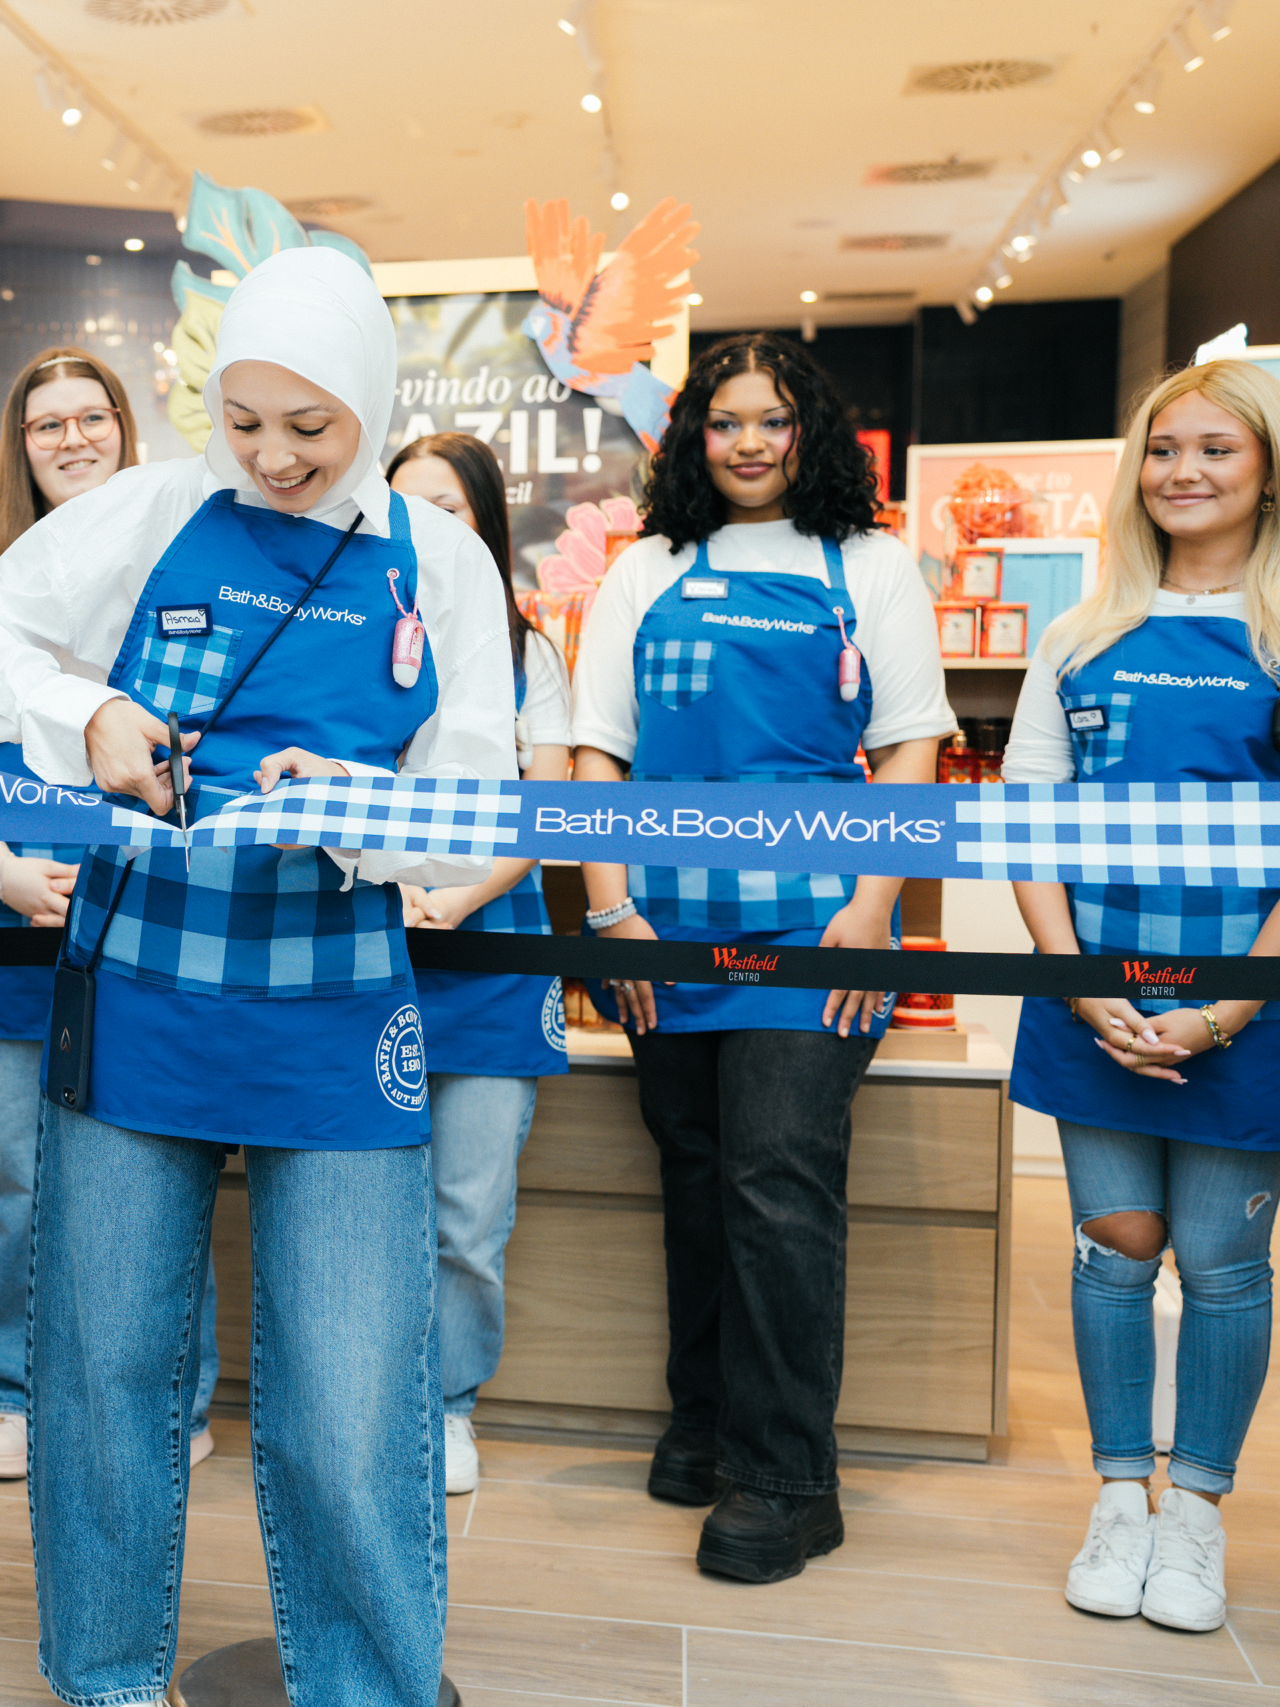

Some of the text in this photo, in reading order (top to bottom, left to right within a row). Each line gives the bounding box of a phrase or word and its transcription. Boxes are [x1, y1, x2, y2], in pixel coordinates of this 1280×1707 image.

[521, 373, 573, 405] ao
[711, 946, 780, 971] Westfield
[728, 971, 760, 983] CENTRO
[1121, 960, 1197, 984] Westfield
[1141, 986, 1175, 996] CENTRO
[380, 1038, 393, 1084] BATH
